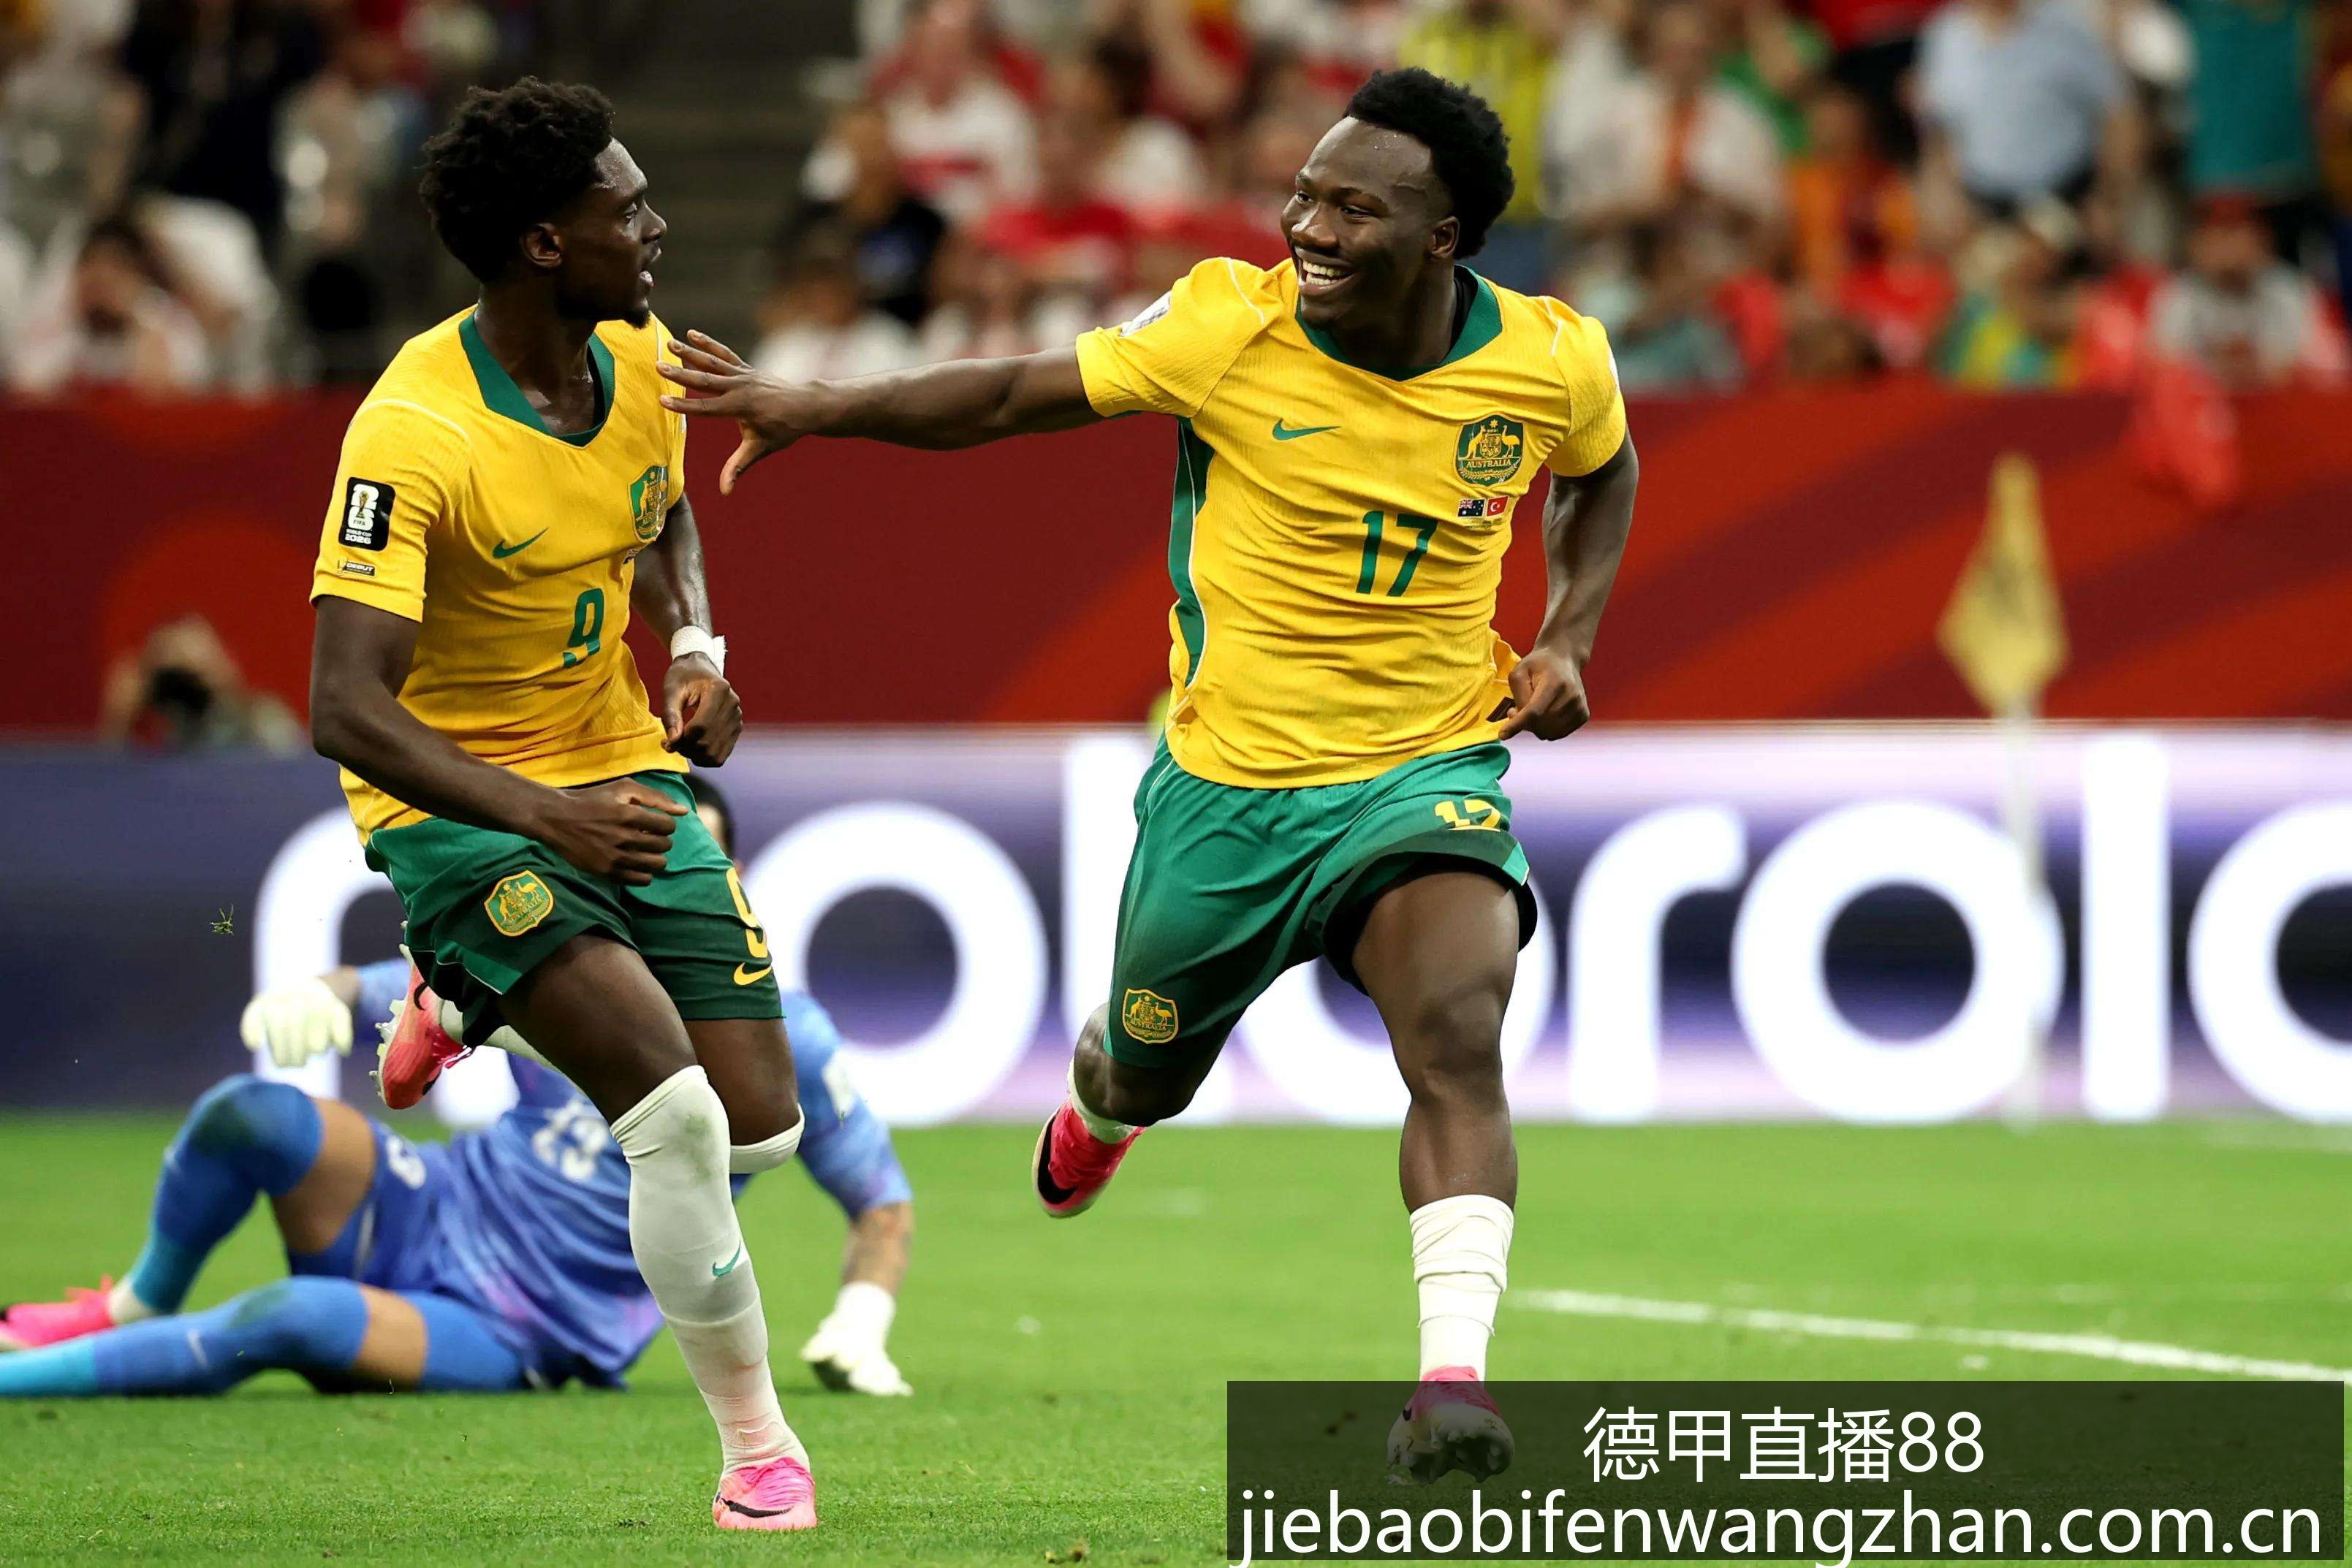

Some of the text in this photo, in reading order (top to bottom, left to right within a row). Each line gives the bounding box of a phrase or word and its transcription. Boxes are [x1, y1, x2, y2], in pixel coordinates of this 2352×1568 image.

[1466, 459, 1511, 468] AUSTRALIA
[345, 533, 372, 544] 2026
[353, 519, 366, 527] FIFA
[1356, 510, 1438, 597] 17
[562, 587, 604, 669] 9
[1435, 799, 1501, 831] 17
[726, 867, 769, 959] 9
